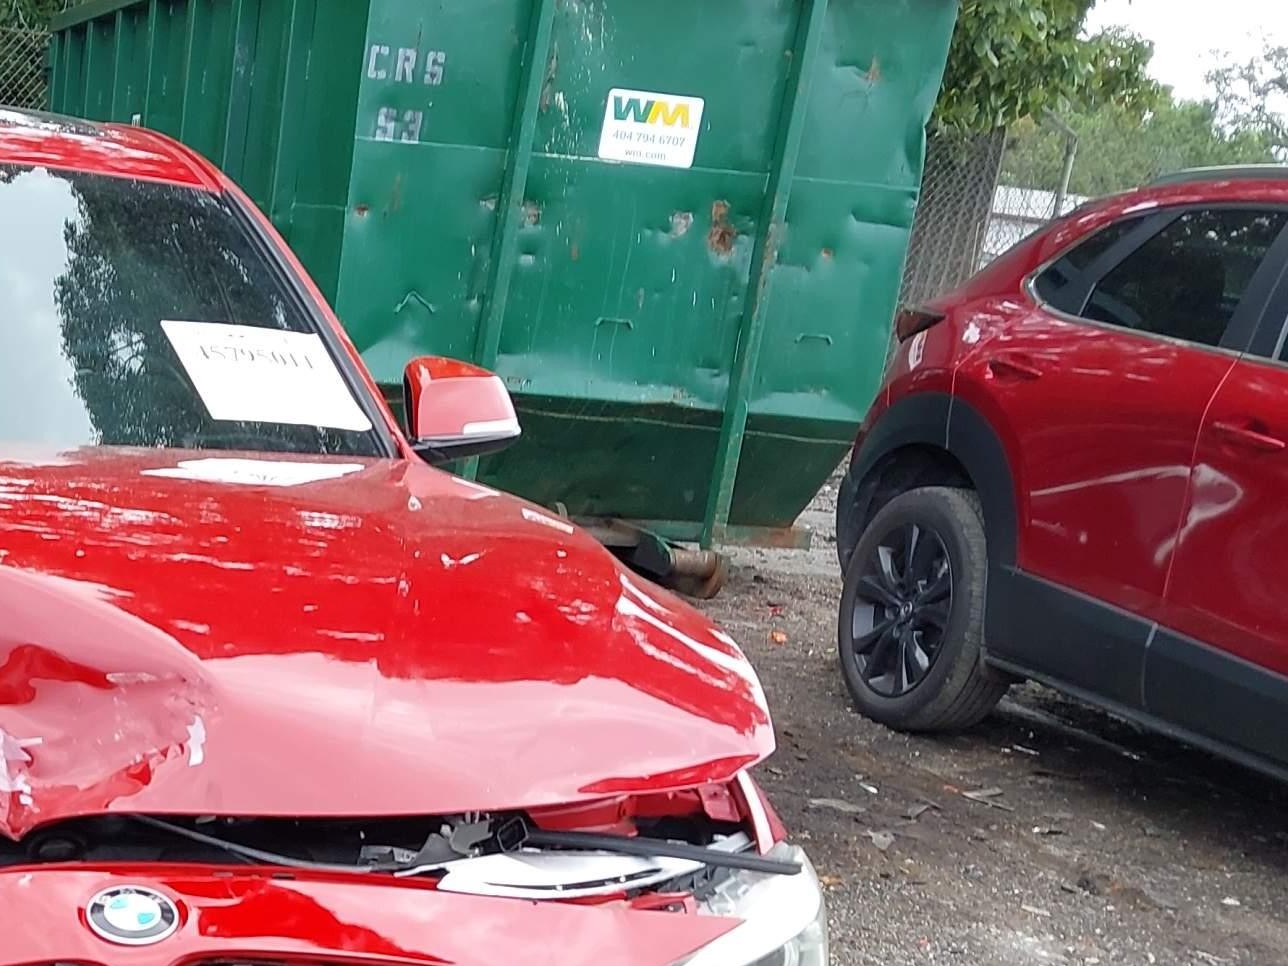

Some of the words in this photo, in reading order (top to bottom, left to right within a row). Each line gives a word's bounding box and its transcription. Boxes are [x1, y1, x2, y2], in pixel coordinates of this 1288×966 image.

[367, 43, 446, 85] CRS
[613, 95, 690, 129] WM
[612, 128, 633, 143] 404
[636, 132, 655, 144] 794
[658, 134, 686, 147] 6707
[624, 148, 667, 160] wm.com
